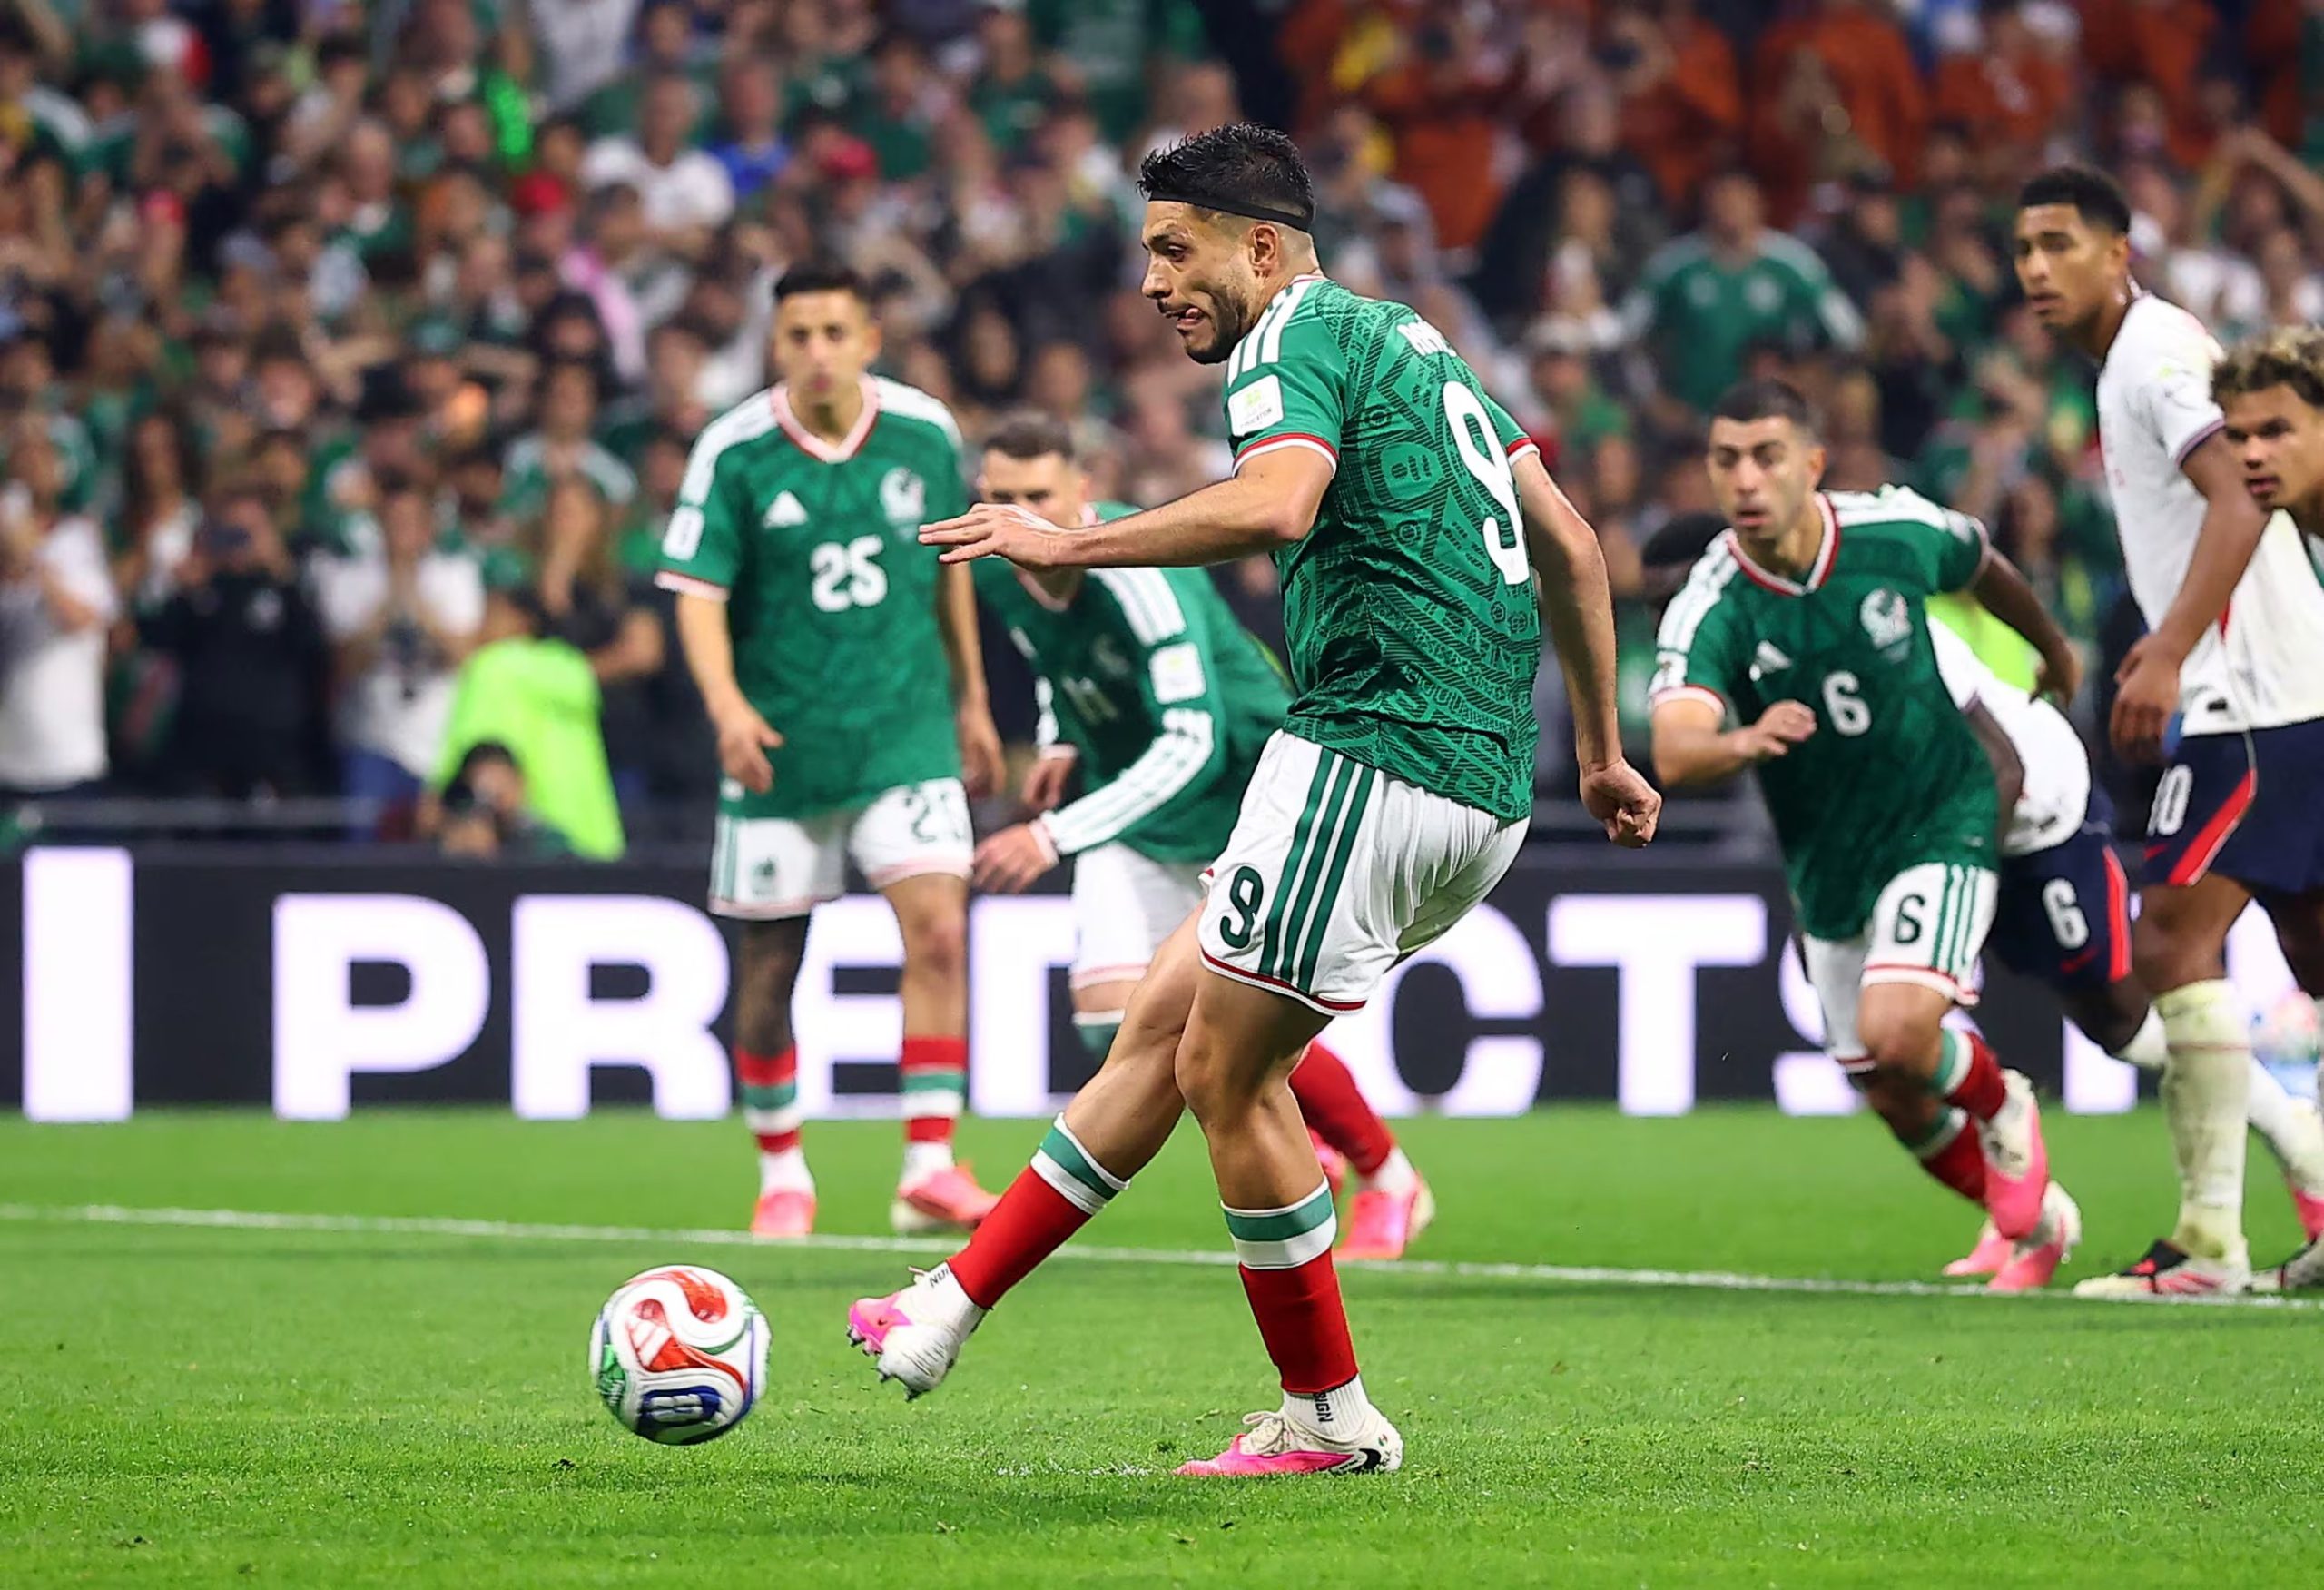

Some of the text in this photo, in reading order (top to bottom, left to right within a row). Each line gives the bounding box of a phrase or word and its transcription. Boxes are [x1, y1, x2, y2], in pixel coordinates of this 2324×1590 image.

[1443, 380, 1531, 586] 9
[810, 534, 889, 612] 25
[1821, 670, 1872, 736] 6
[1220, 865, 1264, 950] 9
[1894, 894, 1926, 944] 6
[2043, 877, 2090, 950] 6
